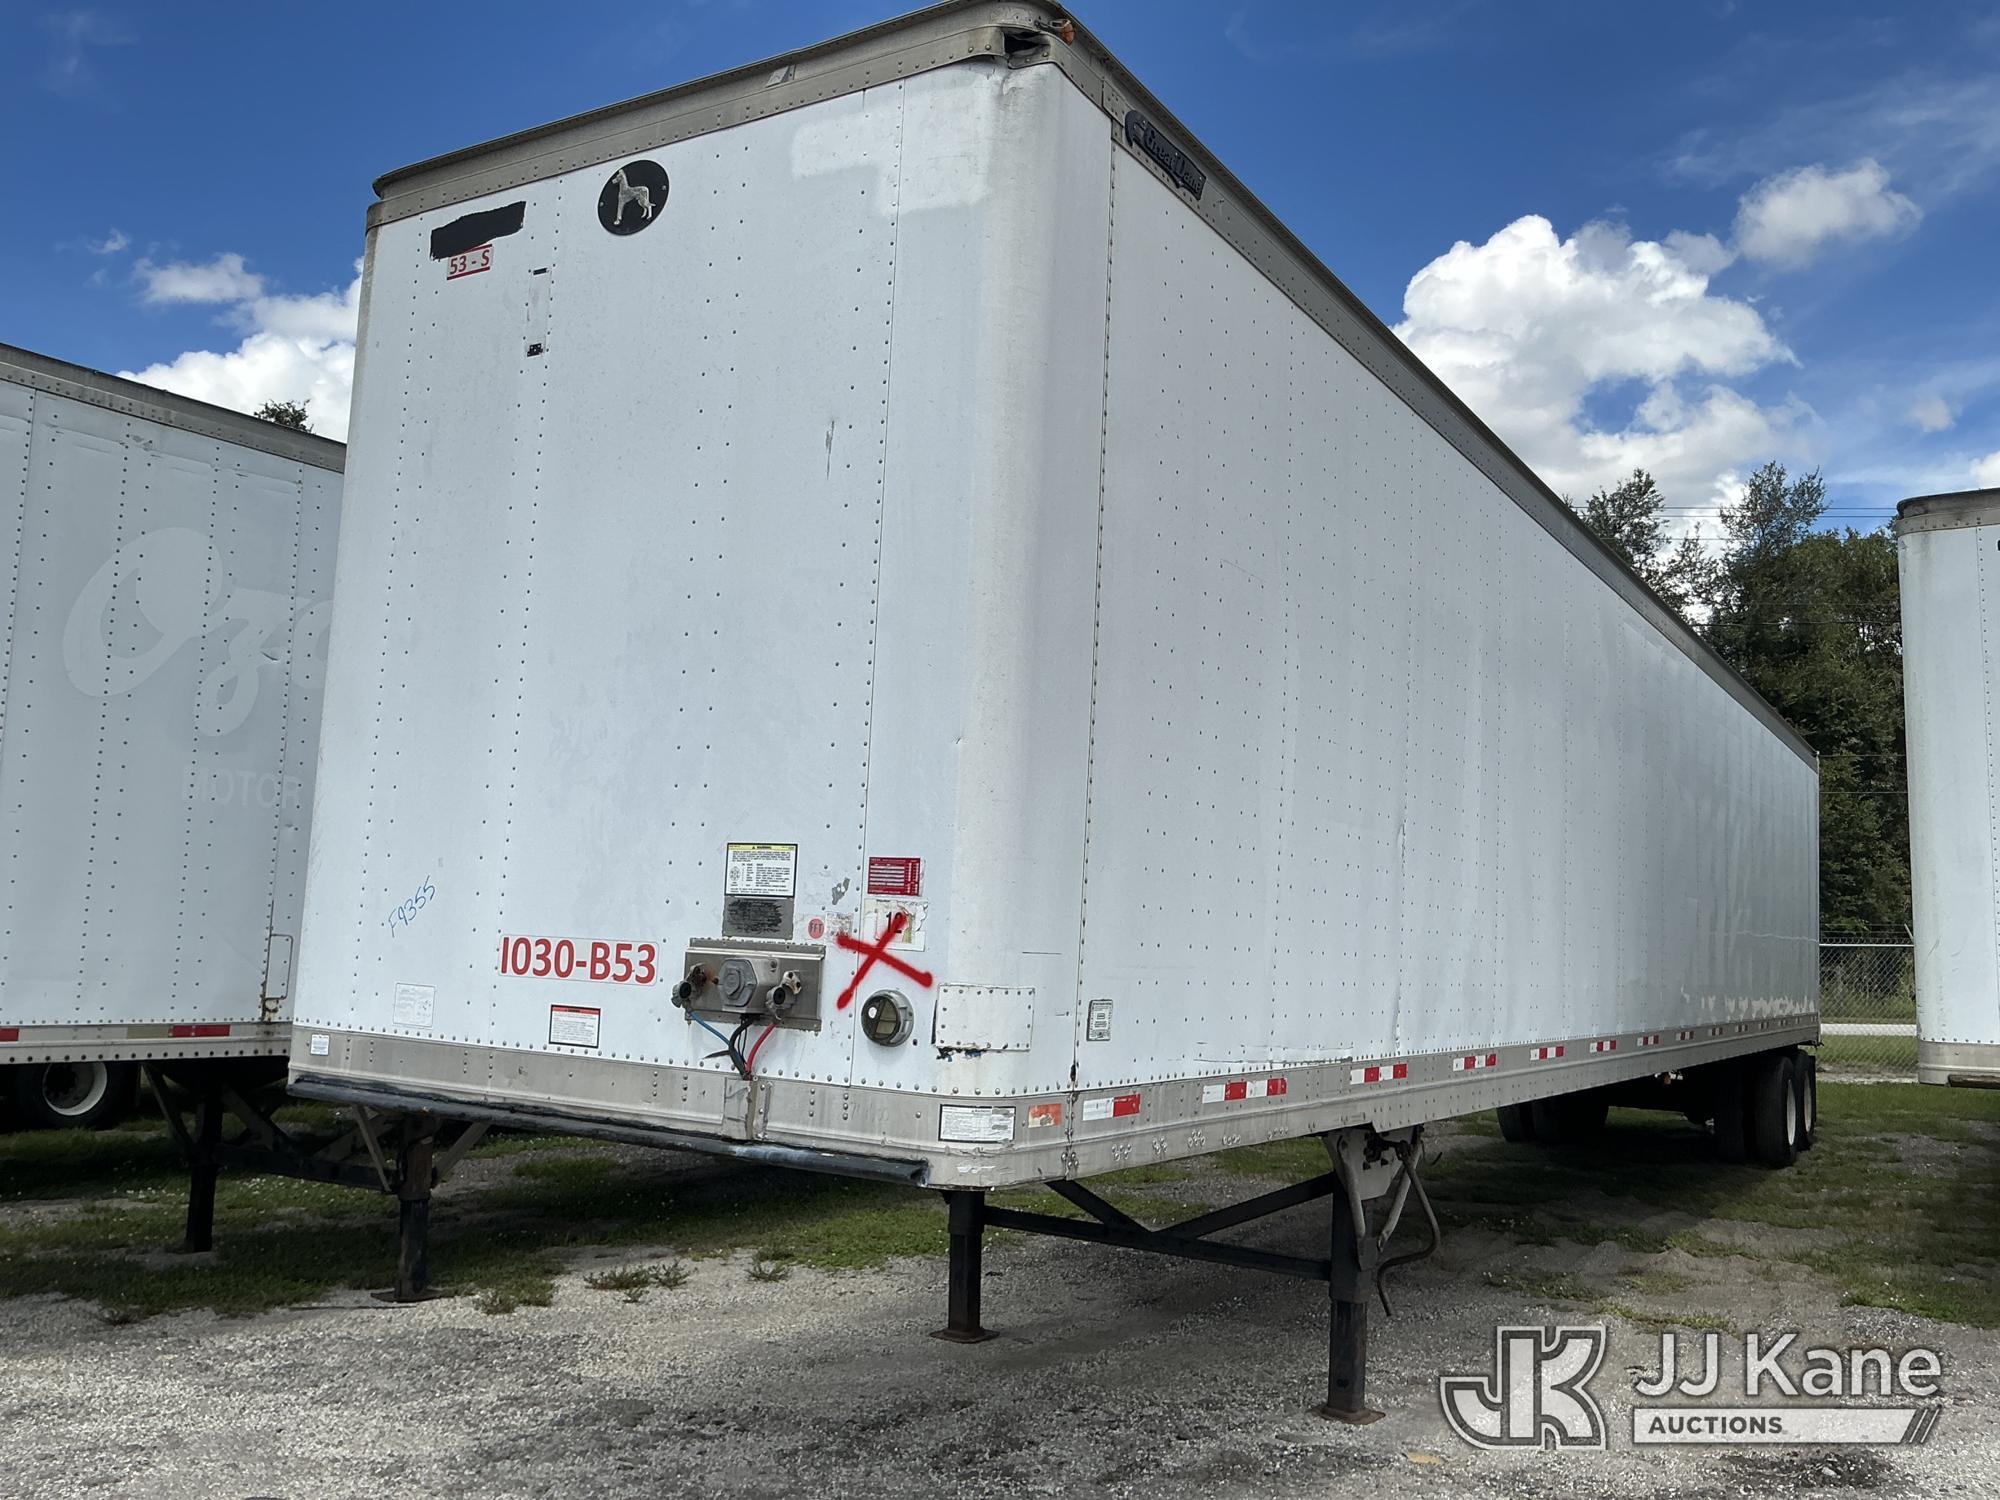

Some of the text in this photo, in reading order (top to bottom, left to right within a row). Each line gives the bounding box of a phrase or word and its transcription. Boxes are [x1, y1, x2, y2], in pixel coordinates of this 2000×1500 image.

[449, 255, 467, 275] 53
[181, 765, 303, 810] MOTOR
[501, 936, 656, 984] 1030-B53
